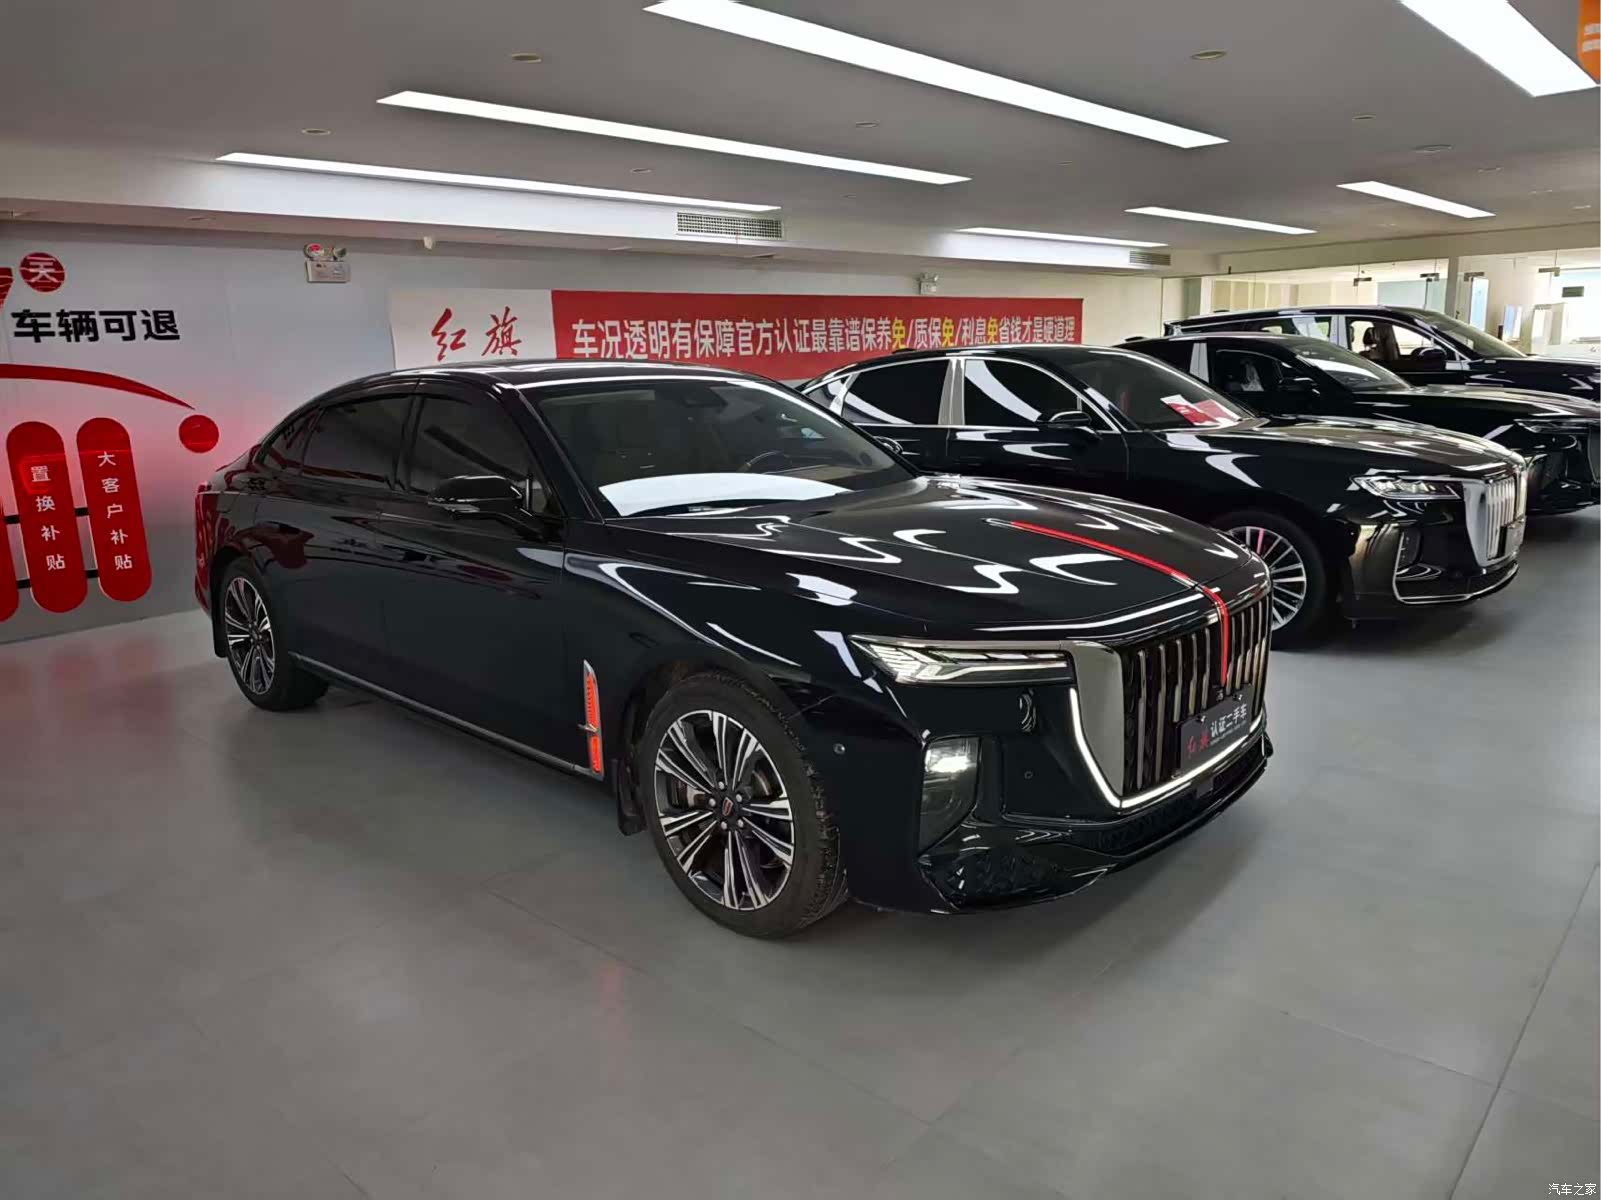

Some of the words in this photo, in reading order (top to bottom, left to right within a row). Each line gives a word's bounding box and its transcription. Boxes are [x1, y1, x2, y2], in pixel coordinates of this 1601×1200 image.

[29, 261, 59, 283] 天
[11, 309, 180, 343] 车辆可退
[431, 306, 523, 362] 红旗
[31, 465, 66, 571] 置换补贴
[97, 451, 133, 571] 大客户补贴
